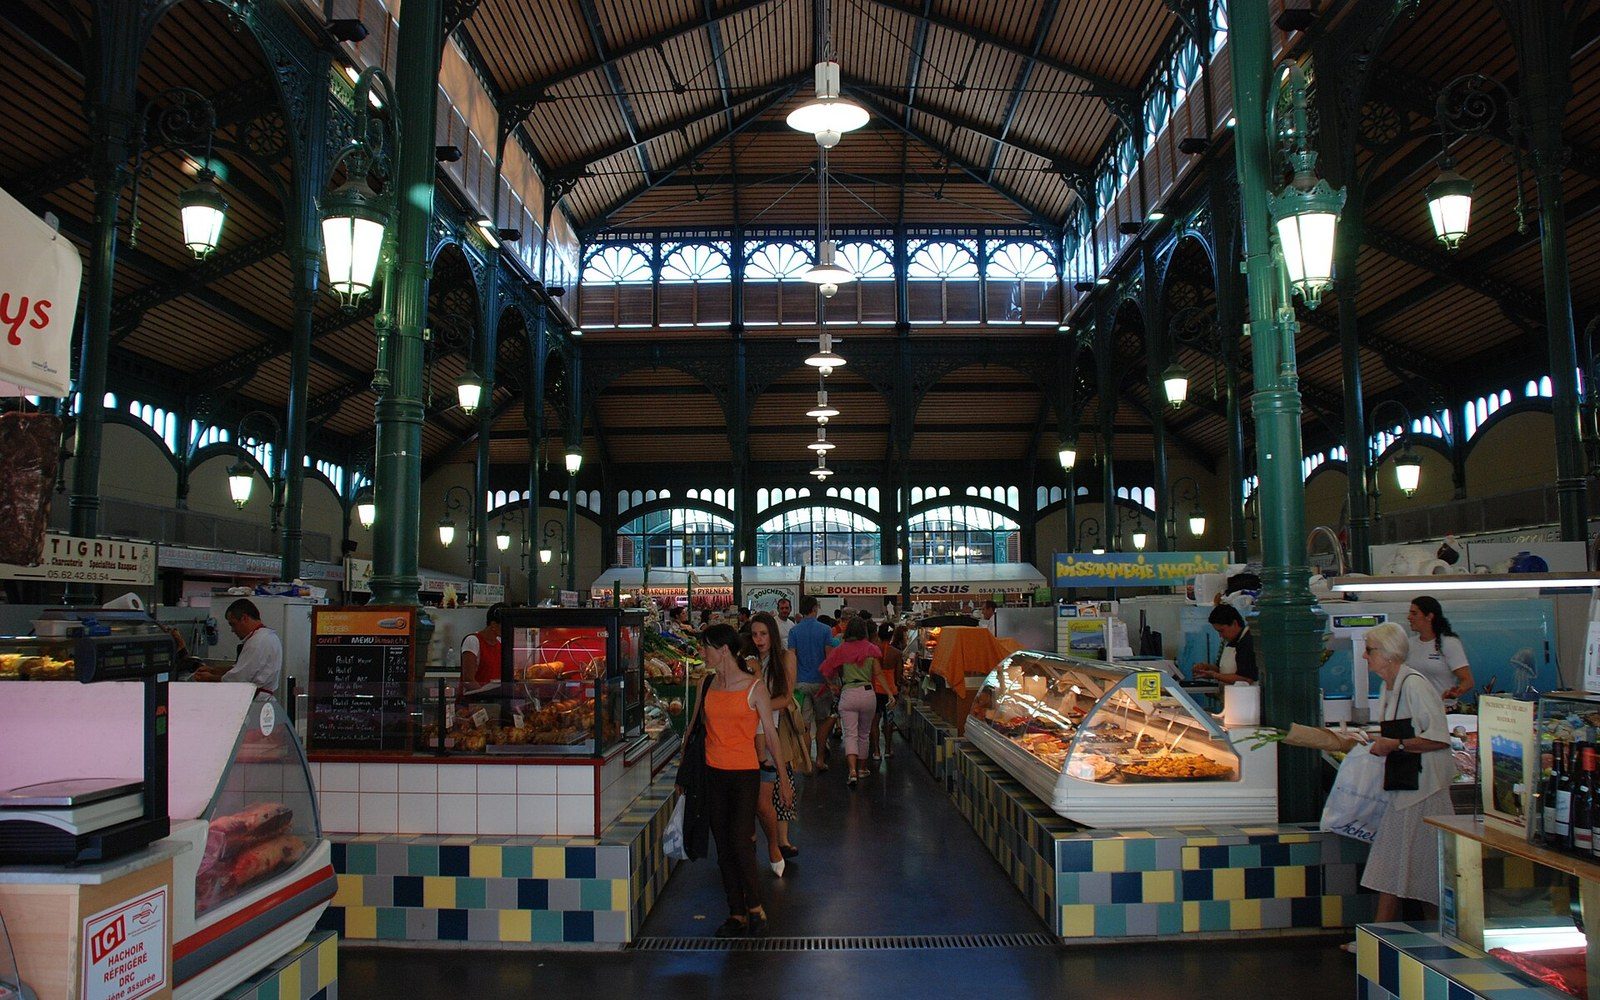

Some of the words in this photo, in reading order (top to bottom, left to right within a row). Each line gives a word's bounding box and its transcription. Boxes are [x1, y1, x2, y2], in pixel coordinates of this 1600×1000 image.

[52, 557, 83, 568] Charcuterie
[118, 561, 137, 572] Basques
[47, 569, 110, 581] 05.62.42.63.54
[753, 588, 788, 600] BOUCHERIE
[827, 586, 888, 595] BOUCHERIE
[350, 636, 374, 645] MENU
[94, 919, 123, 960] ICI
[108, 941, 145, 968] HACHOIR
[119, 971, 136, 988] DRC
[126, 973, 157, 995] assurée
